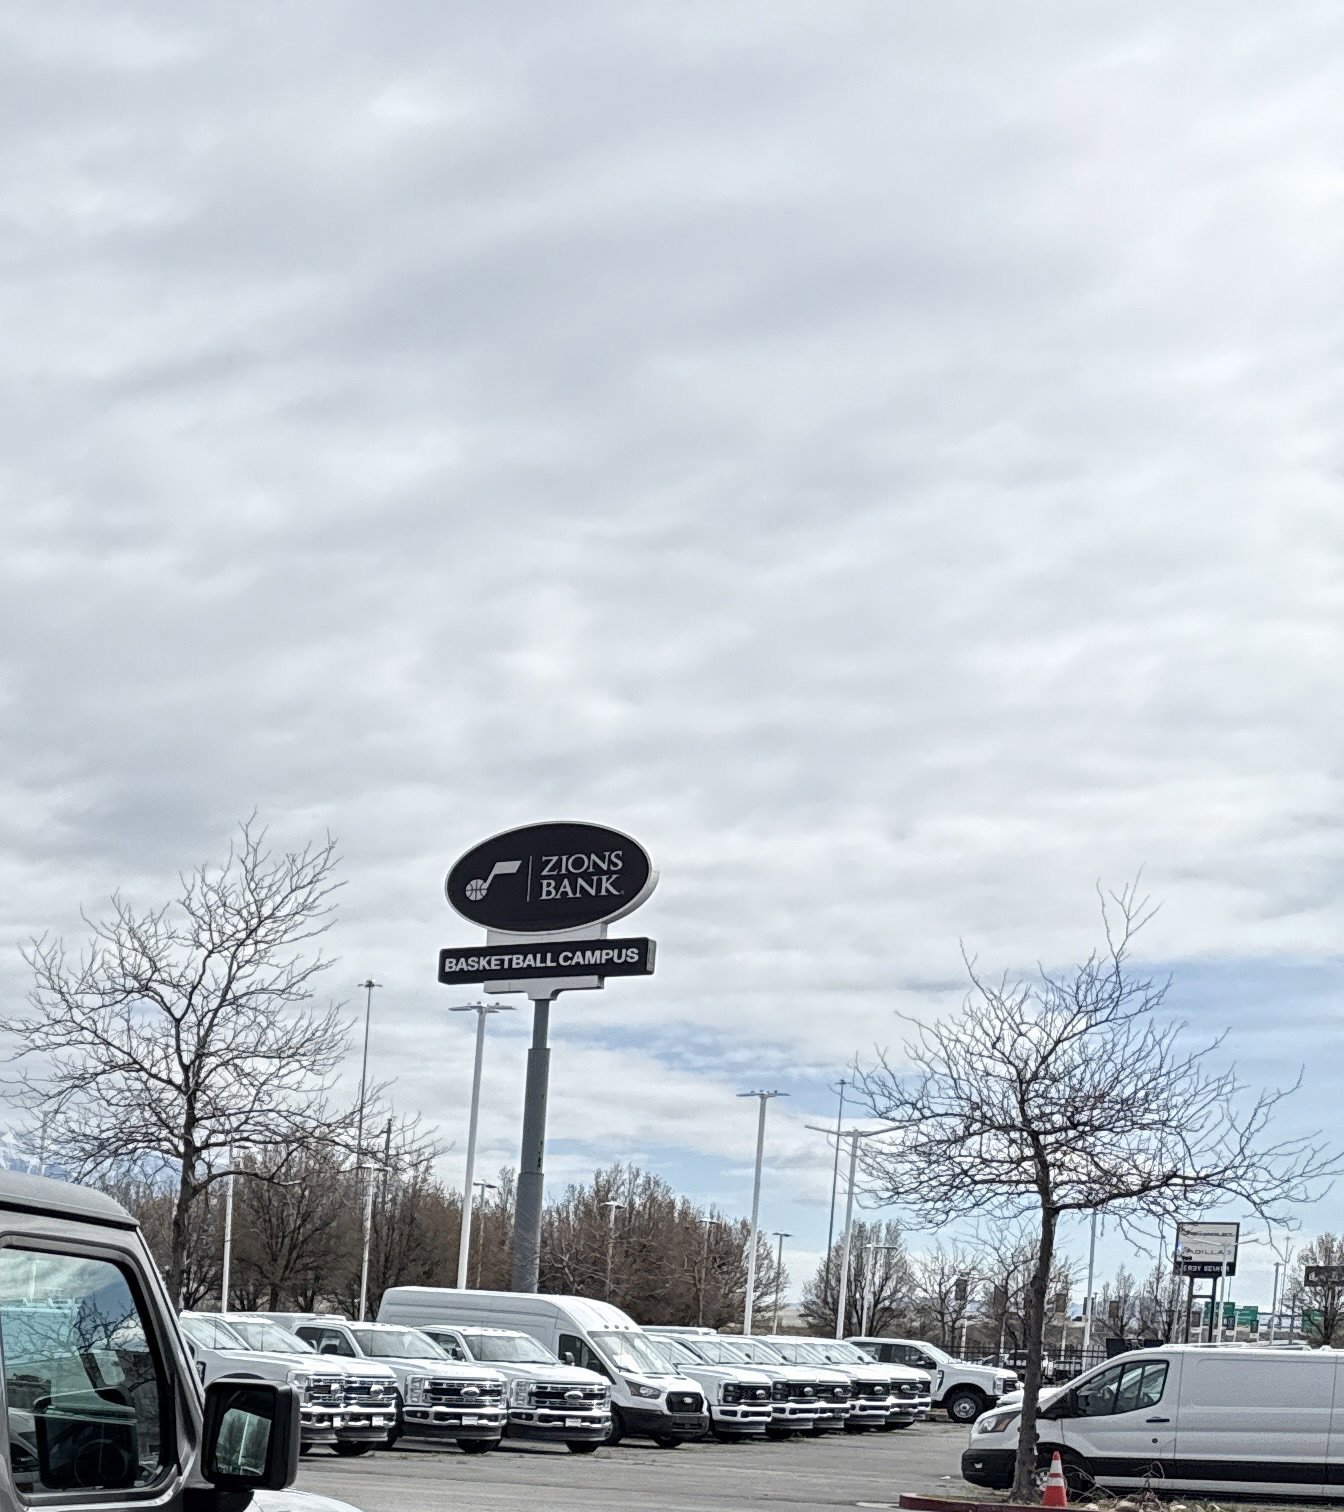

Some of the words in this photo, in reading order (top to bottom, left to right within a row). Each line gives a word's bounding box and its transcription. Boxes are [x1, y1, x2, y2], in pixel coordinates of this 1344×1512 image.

[540, 850, 623, 876] ZIONS
[538, 874, 621, 900] BANK
[444, 952, 557, 972] BASKETBALL
[558, 948, 639, 966] CAMPUS
